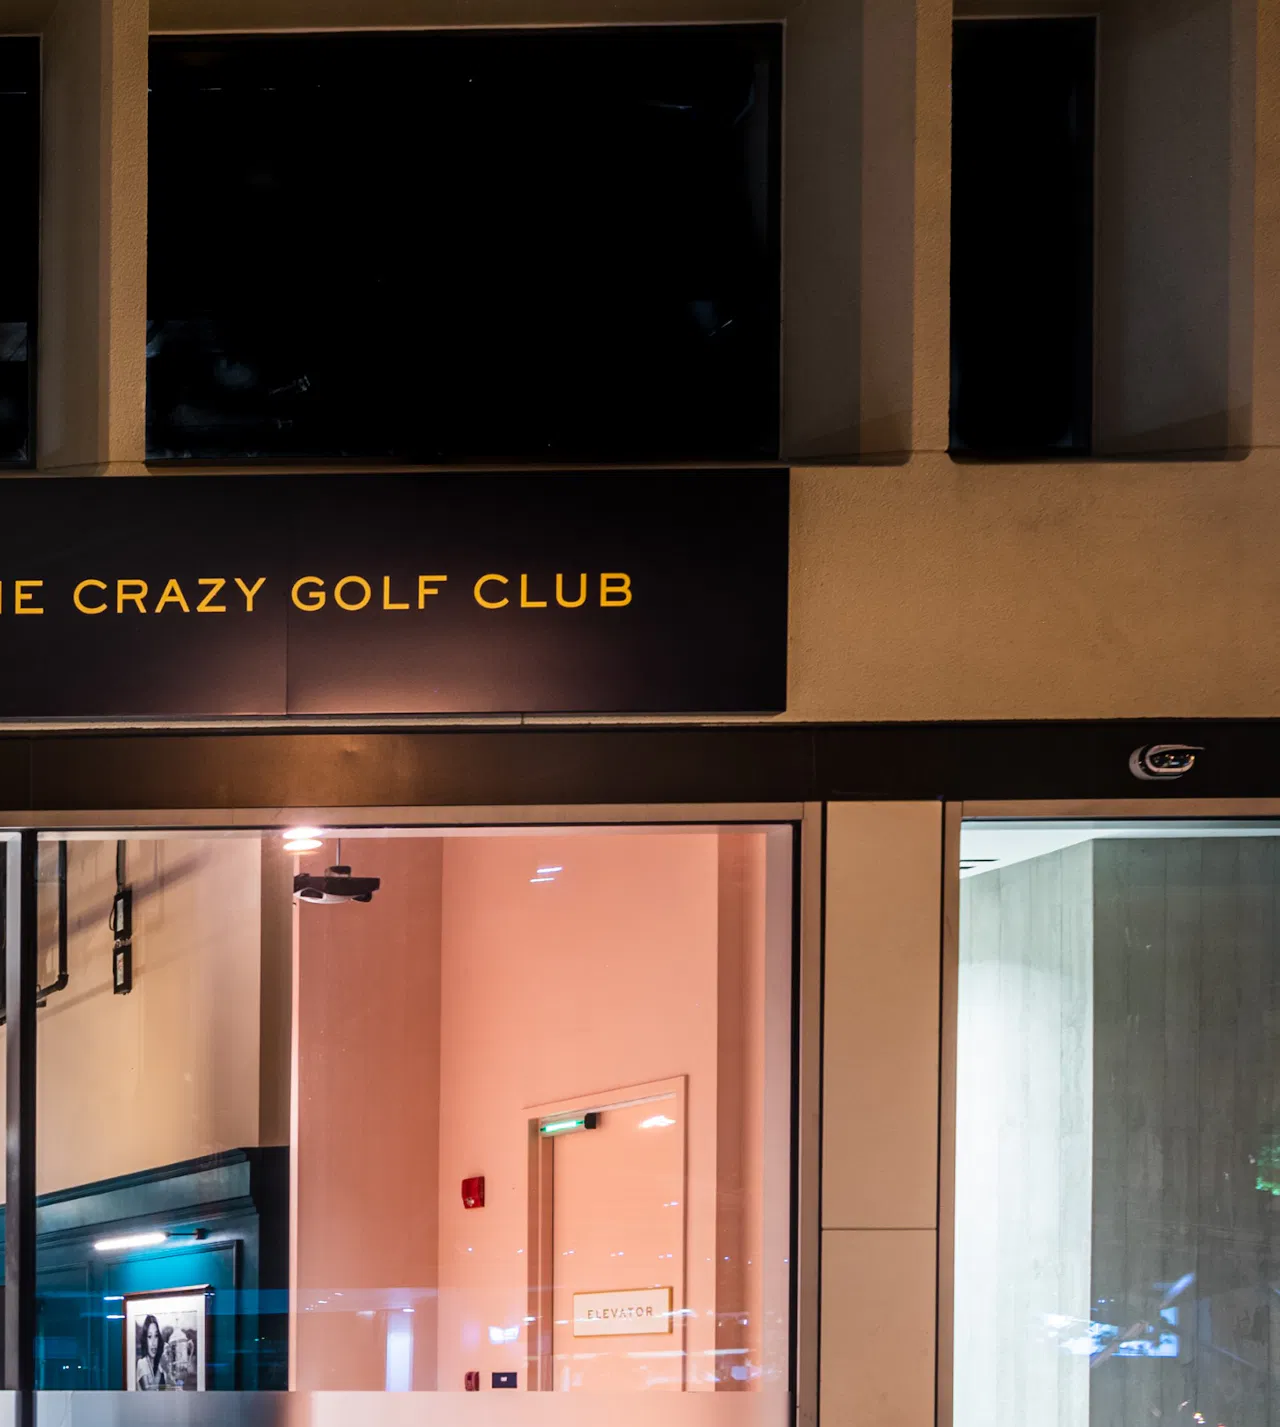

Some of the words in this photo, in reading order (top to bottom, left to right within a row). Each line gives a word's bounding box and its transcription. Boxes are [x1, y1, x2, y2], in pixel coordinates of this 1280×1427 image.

[73, 577, 267, 614] CRAZY
[291, 575, 448, 611] GOLF
[473, 573, 632, 608] CLUB
[587, 1306, 653, 1320] ELEVATOR
